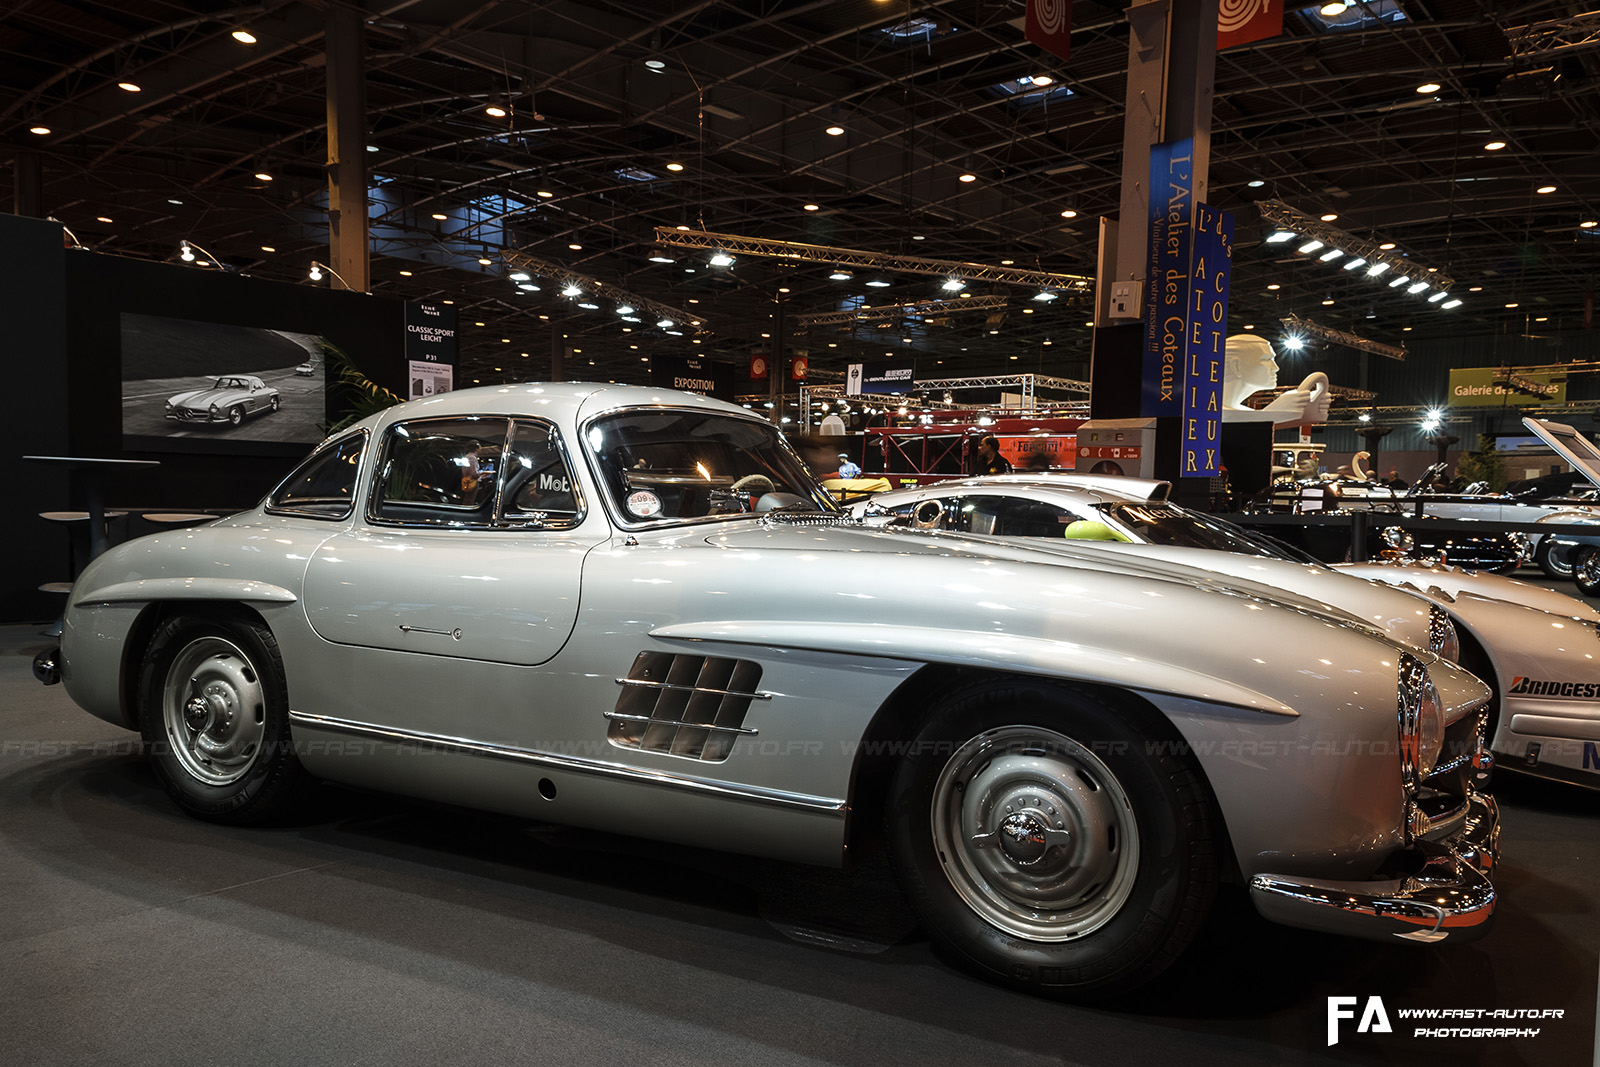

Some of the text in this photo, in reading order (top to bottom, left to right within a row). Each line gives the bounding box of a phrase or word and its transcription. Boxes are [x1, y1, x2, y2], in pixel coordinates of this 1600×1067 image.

[1216, 213, 1232, 258] des
[1151, 266, 1163, 278] de
[1160, 155, 1191, 401] L'Atelier des Coteaux
[1149, 279, 1161, 302] votre
[1147, 303, 1160, 339] passion
[407, 324, 455, 337] CLASSIC SPORT
[420, 334, 442, 343] LEICHT
[1204, 271, 1225, 470] COTEAUX
[674, 377, 715, 391] EXPOSITION
[1454, 385, 1493, 397] Galerie
